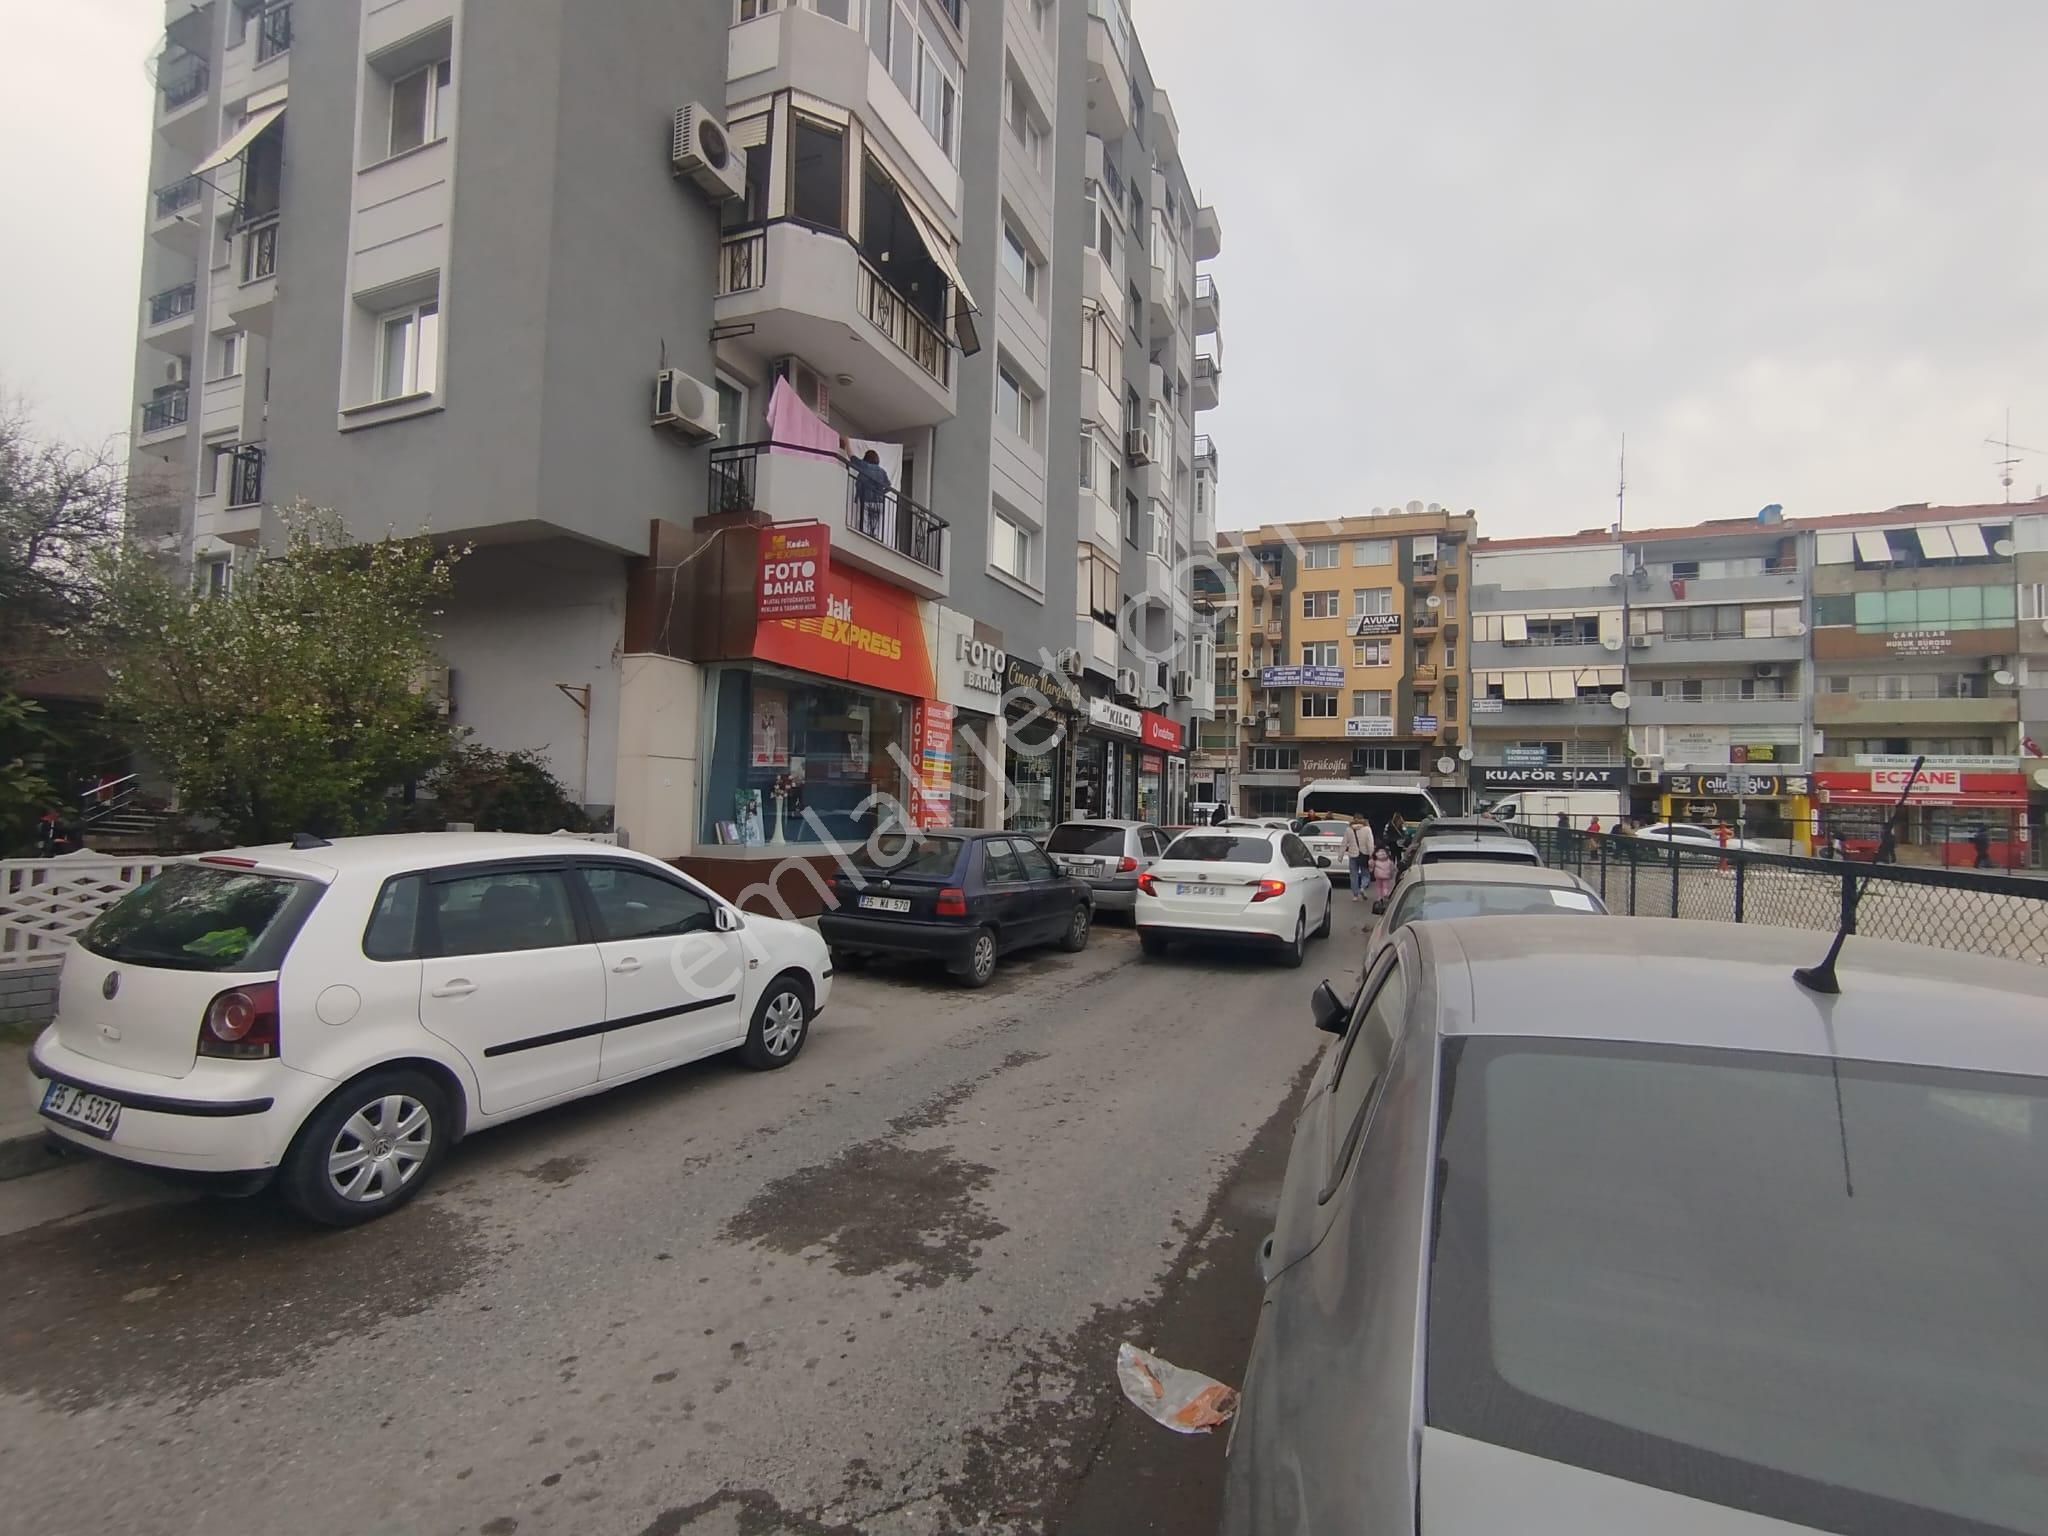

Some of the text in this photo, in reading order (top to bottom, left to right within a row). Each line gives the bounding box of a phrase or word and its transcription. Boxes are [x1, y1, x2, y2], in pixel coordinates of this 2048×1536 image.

[786, 538, 810, 549] Kodak
[764, 561, 816, 581] FOTO
[764, 580, 815, 596] BAHAR
[1363, 616, 1399, 625] AVUKAT
[821, 617, 902, 660] EXPRESS
[1886, 640, 1914, 648] HUKUK
[957, 633, 1006, 674] FOTO
[966, 671, 1002, 695] BAHAR
[1158, 728, 1175, 741] vodafone
[911, 707, 922, 828] FOTO BAHA
[1302, 758, 1348, 775] Yörükoğlu
[1485, 768, 1610, 782] KUAFÖR SUAT
[1875, 771, 1957, 785] ECZANE
[864, 897, 909, 911] 35 NA 570
[50, 1085, 69, 1110] 35
[84, 1097, 118, 1129] 5374
